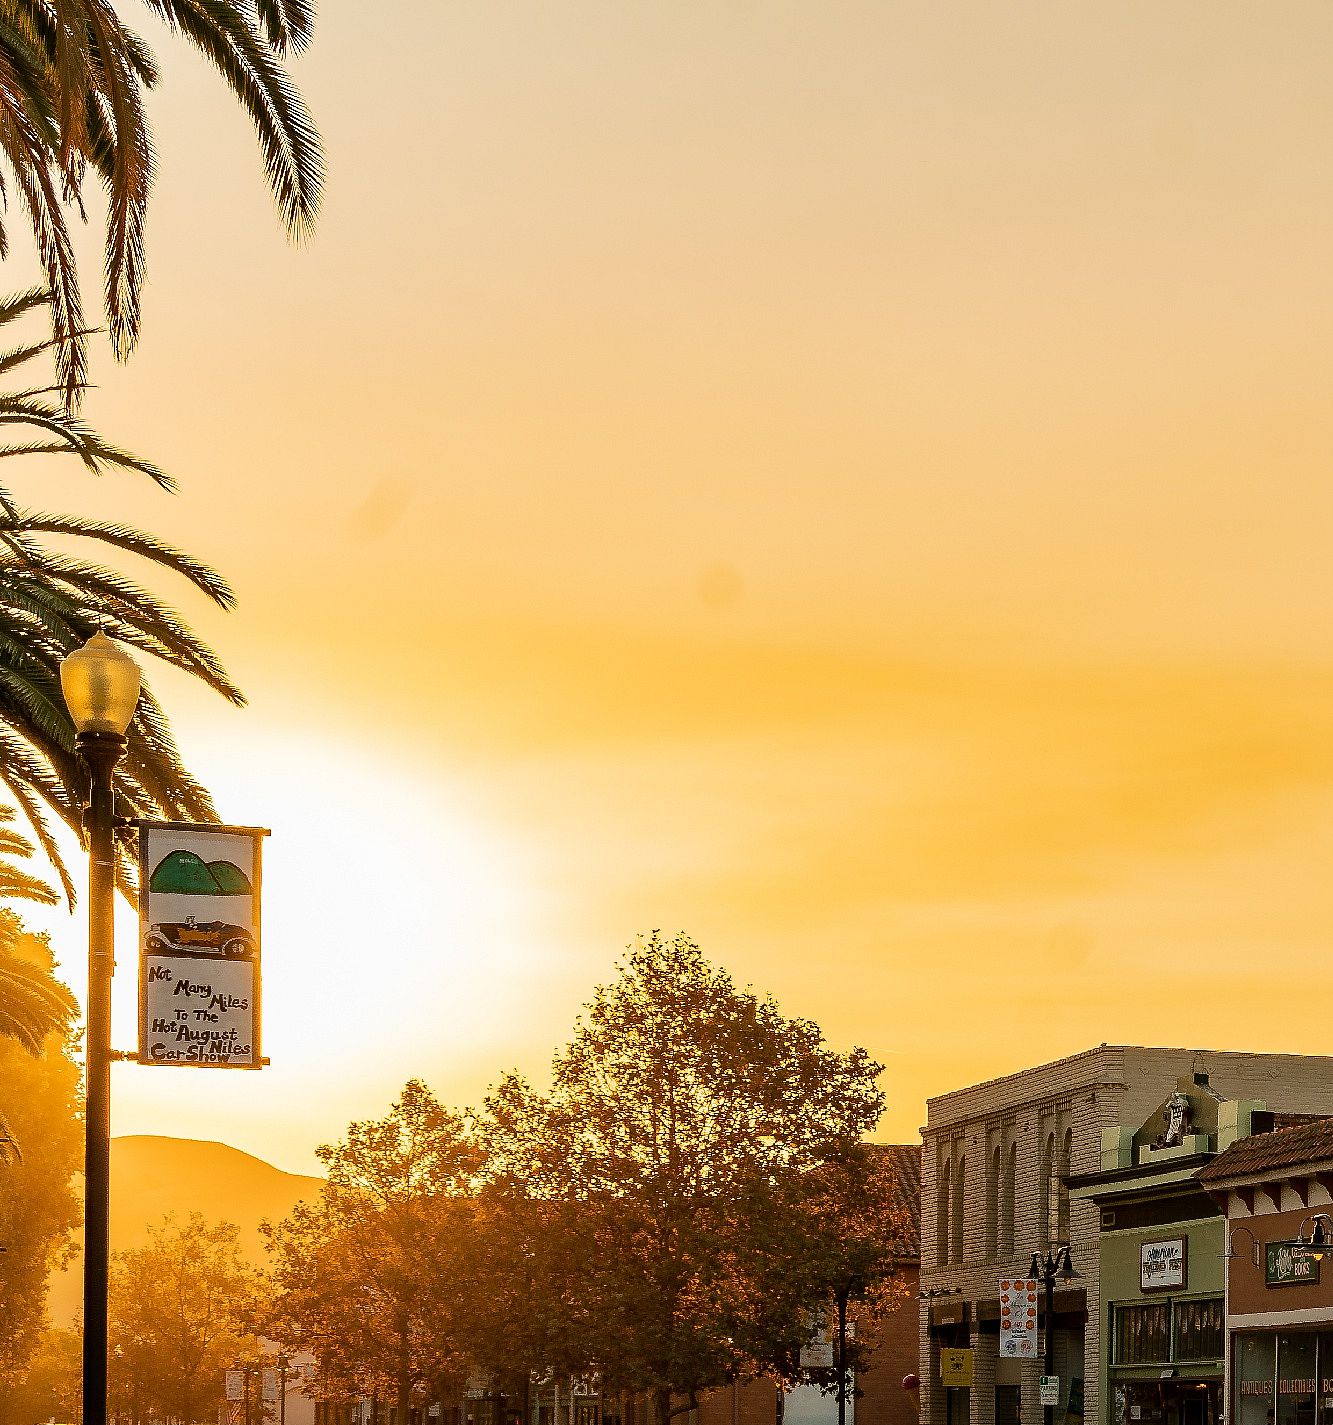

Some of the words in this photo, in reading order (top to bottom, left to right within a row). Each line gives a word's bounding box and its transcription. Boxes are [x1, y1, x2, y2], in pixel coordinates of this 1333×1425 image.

[148, 966, 172, 982] Not
[173, 980, 212, 998] Many
[208, 994, 249, 1012] Miles
[174, 1009, 189, 1020] To
[193, 1009, 218, 1023] The
[152, 1018, 177, 1033] Hot
[176, 1024, 238, 1045] August
[151, 1042, 185, 1060] Car
[186, 1044, 231, 1062] Show
[208, 1040, 250, 1055] Niles
[1241, 1380, 1273, 1395] ANTIQUES
[1279, 1378, 1316, 1394] COLLECTIBLES
